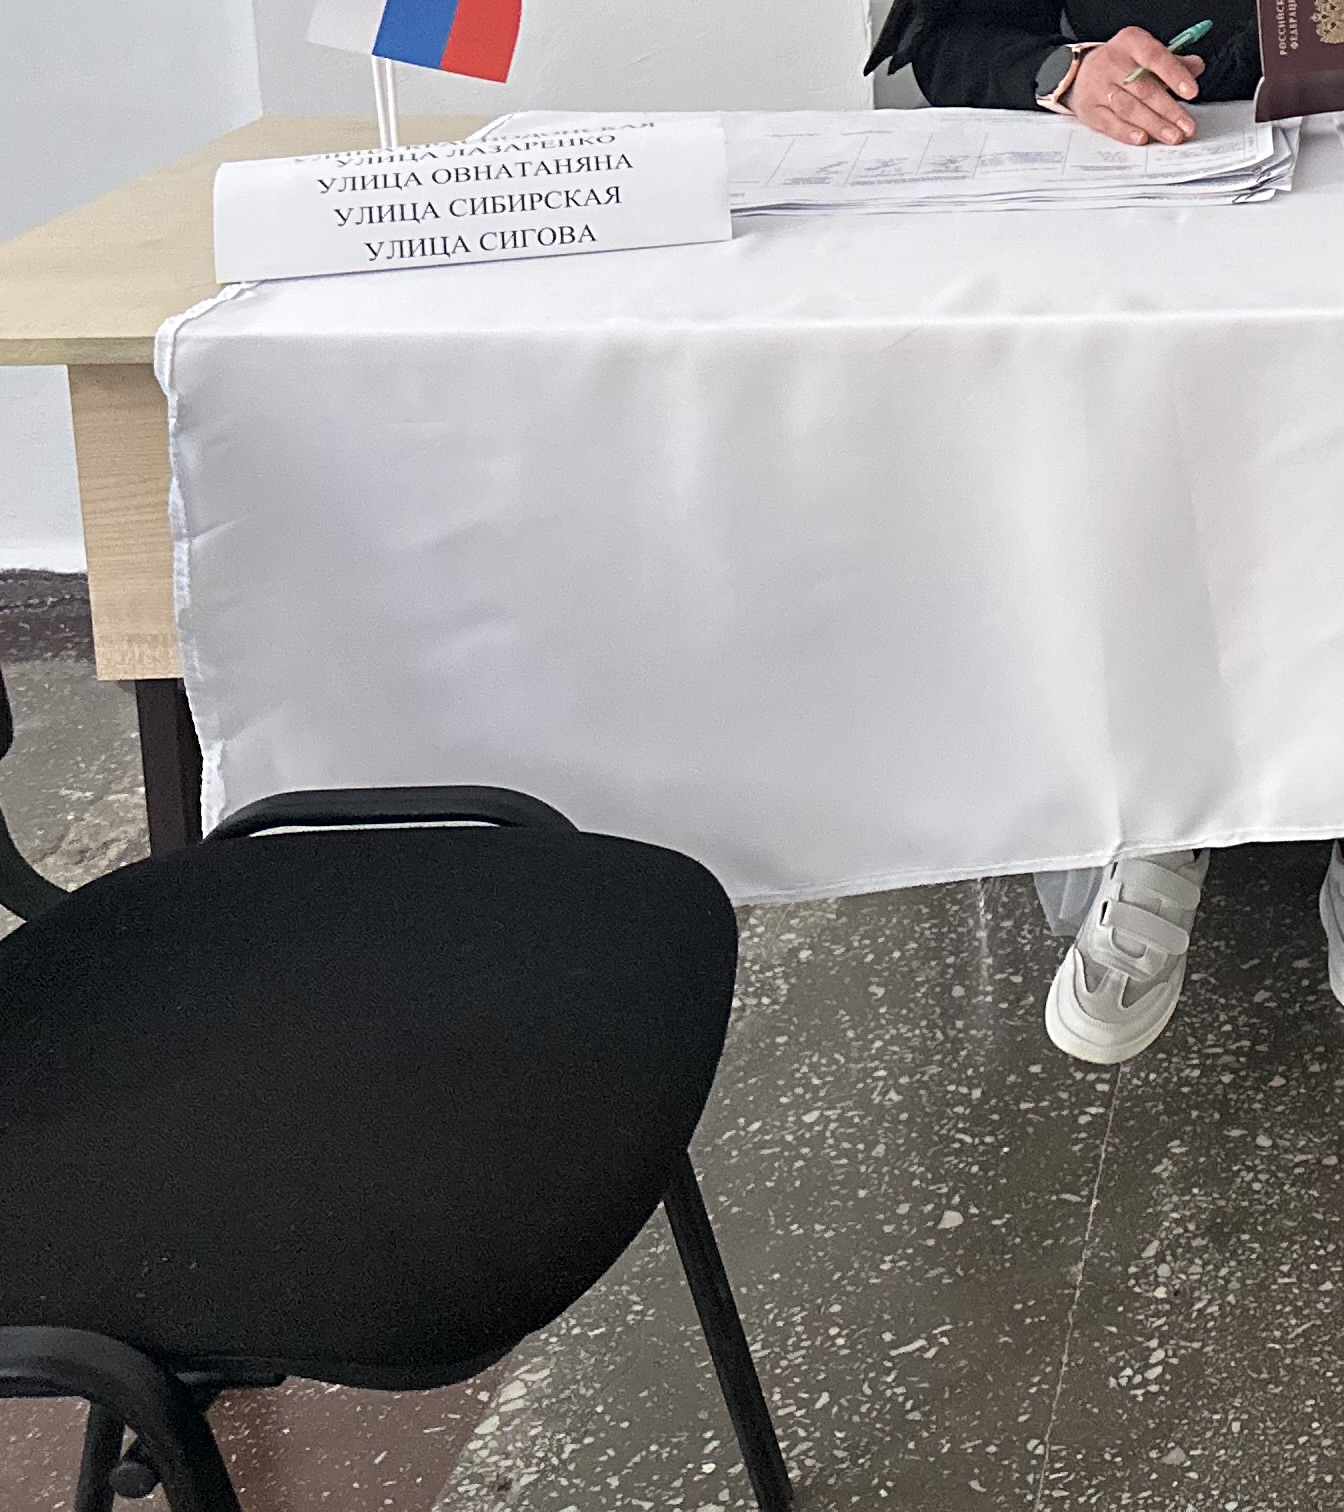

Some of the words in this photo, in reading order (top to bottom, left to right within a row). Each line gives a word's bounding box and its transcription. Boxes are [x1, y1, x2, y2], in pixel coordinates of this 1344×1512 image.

[336, 151, 439, 168] УЛИЦА
[446, 134, 616, 157] ЛАЗАРЕНКО
[317, 172, 424, 194] УЛИЦА
[431, 152, 635, 186] ОВНАТАНЯНА
[334, 202, 439, 228] УЛИЦА
[448, 185, 623, 220] СИБИРСКАЯ
[364, 235, 472, 262] УЛИЦА
[479, 224, 598, 254] СИГОВА
